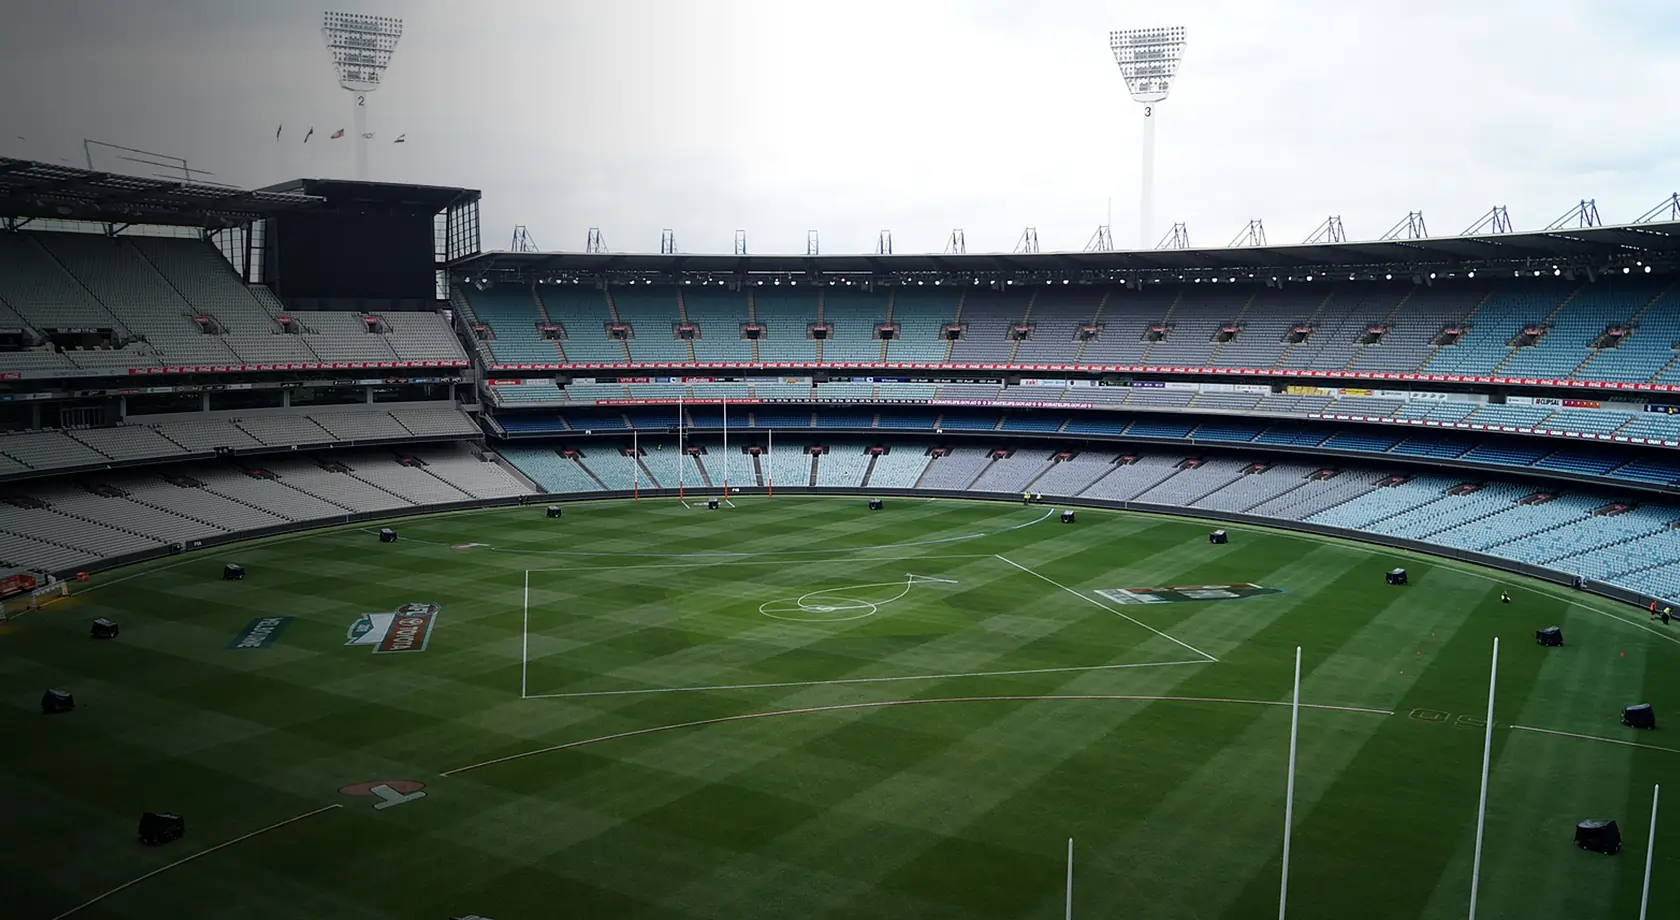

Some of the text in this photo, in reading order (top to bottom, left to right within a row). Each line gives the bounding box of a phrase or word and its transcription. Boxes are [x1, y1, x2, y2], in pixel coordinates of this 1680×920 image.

[358, 96, 365, 106] 2
[1145, 106, 1152, 117] 3
[1541, 398, 1560, 406] CLIPSAL
[405, 603, 432, 616] AFL
[390, 626, 420, 651] TOYOTA
